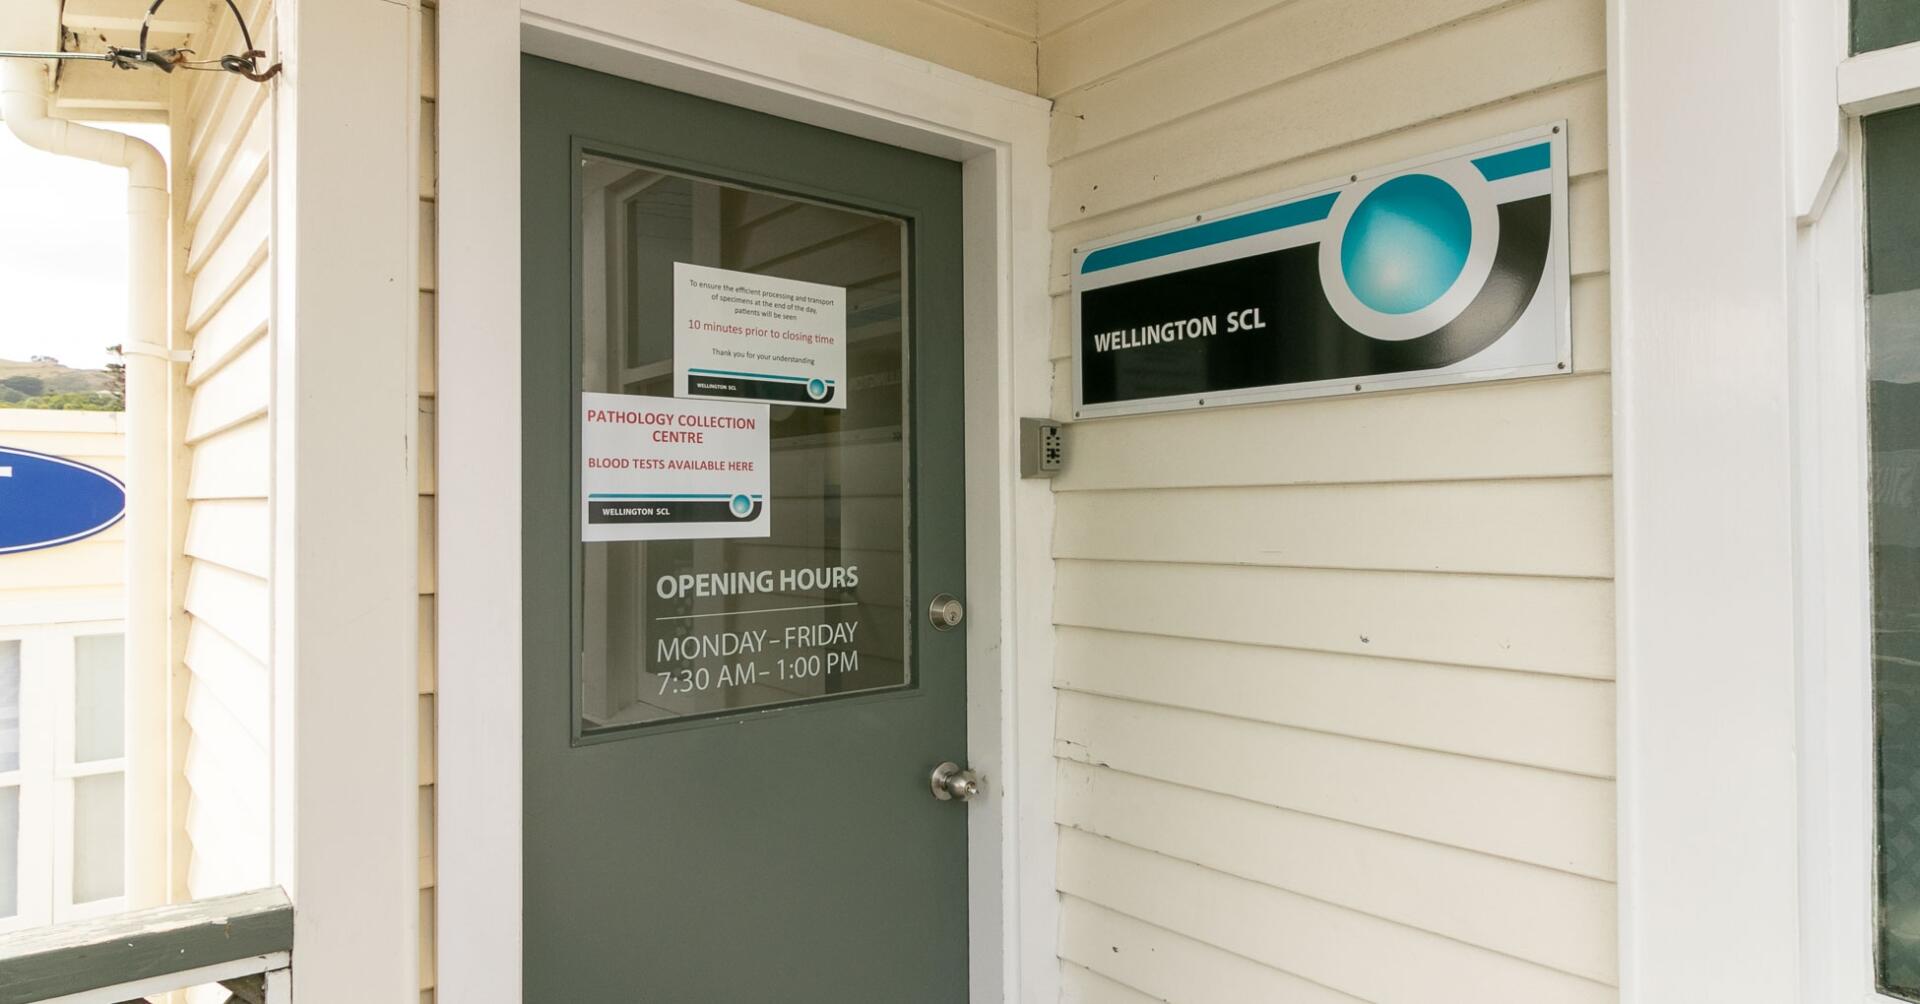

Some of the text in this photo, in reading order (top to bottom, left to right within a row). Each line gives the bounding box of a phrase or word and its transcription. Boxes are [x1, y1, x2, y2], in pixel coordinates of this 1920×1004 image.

[699, 282, 721, 290] ensure
[723, 284, 734, 292] the
[735, 286, 760, 295] efficient
[762, 290, 794, 301] processing
[808, 296, 834, 306] transport
[720, 295, 753, 306] specimens
[774, 301, 785, 309] end
[734, 307, 760, 317] patients
[762, 310, 772, 318] will
[689, 320, 834, 344] 10 minutes prior to closing time
[1094, 308, 1266, 353] WELLINGTON SCL
[712, 348, 732, 357] Thank
[772, 354, 815, 365] understanding
[587, 410, 755, 430] PATHOLOGY COLLECTION
[653, 430, 703, 444] CENTRE
[589, 458, 753, 471] BLOOD TESTS AVAILABLE HERE
[602, 508, 653, 516] WELLINGTON
[657, 565, 859, 600] OPENING HOURS
[657, 667, 709, 696] 7:30
[777, 655, 820, 680] 1:00
[828, 650, 858, 674] PM
